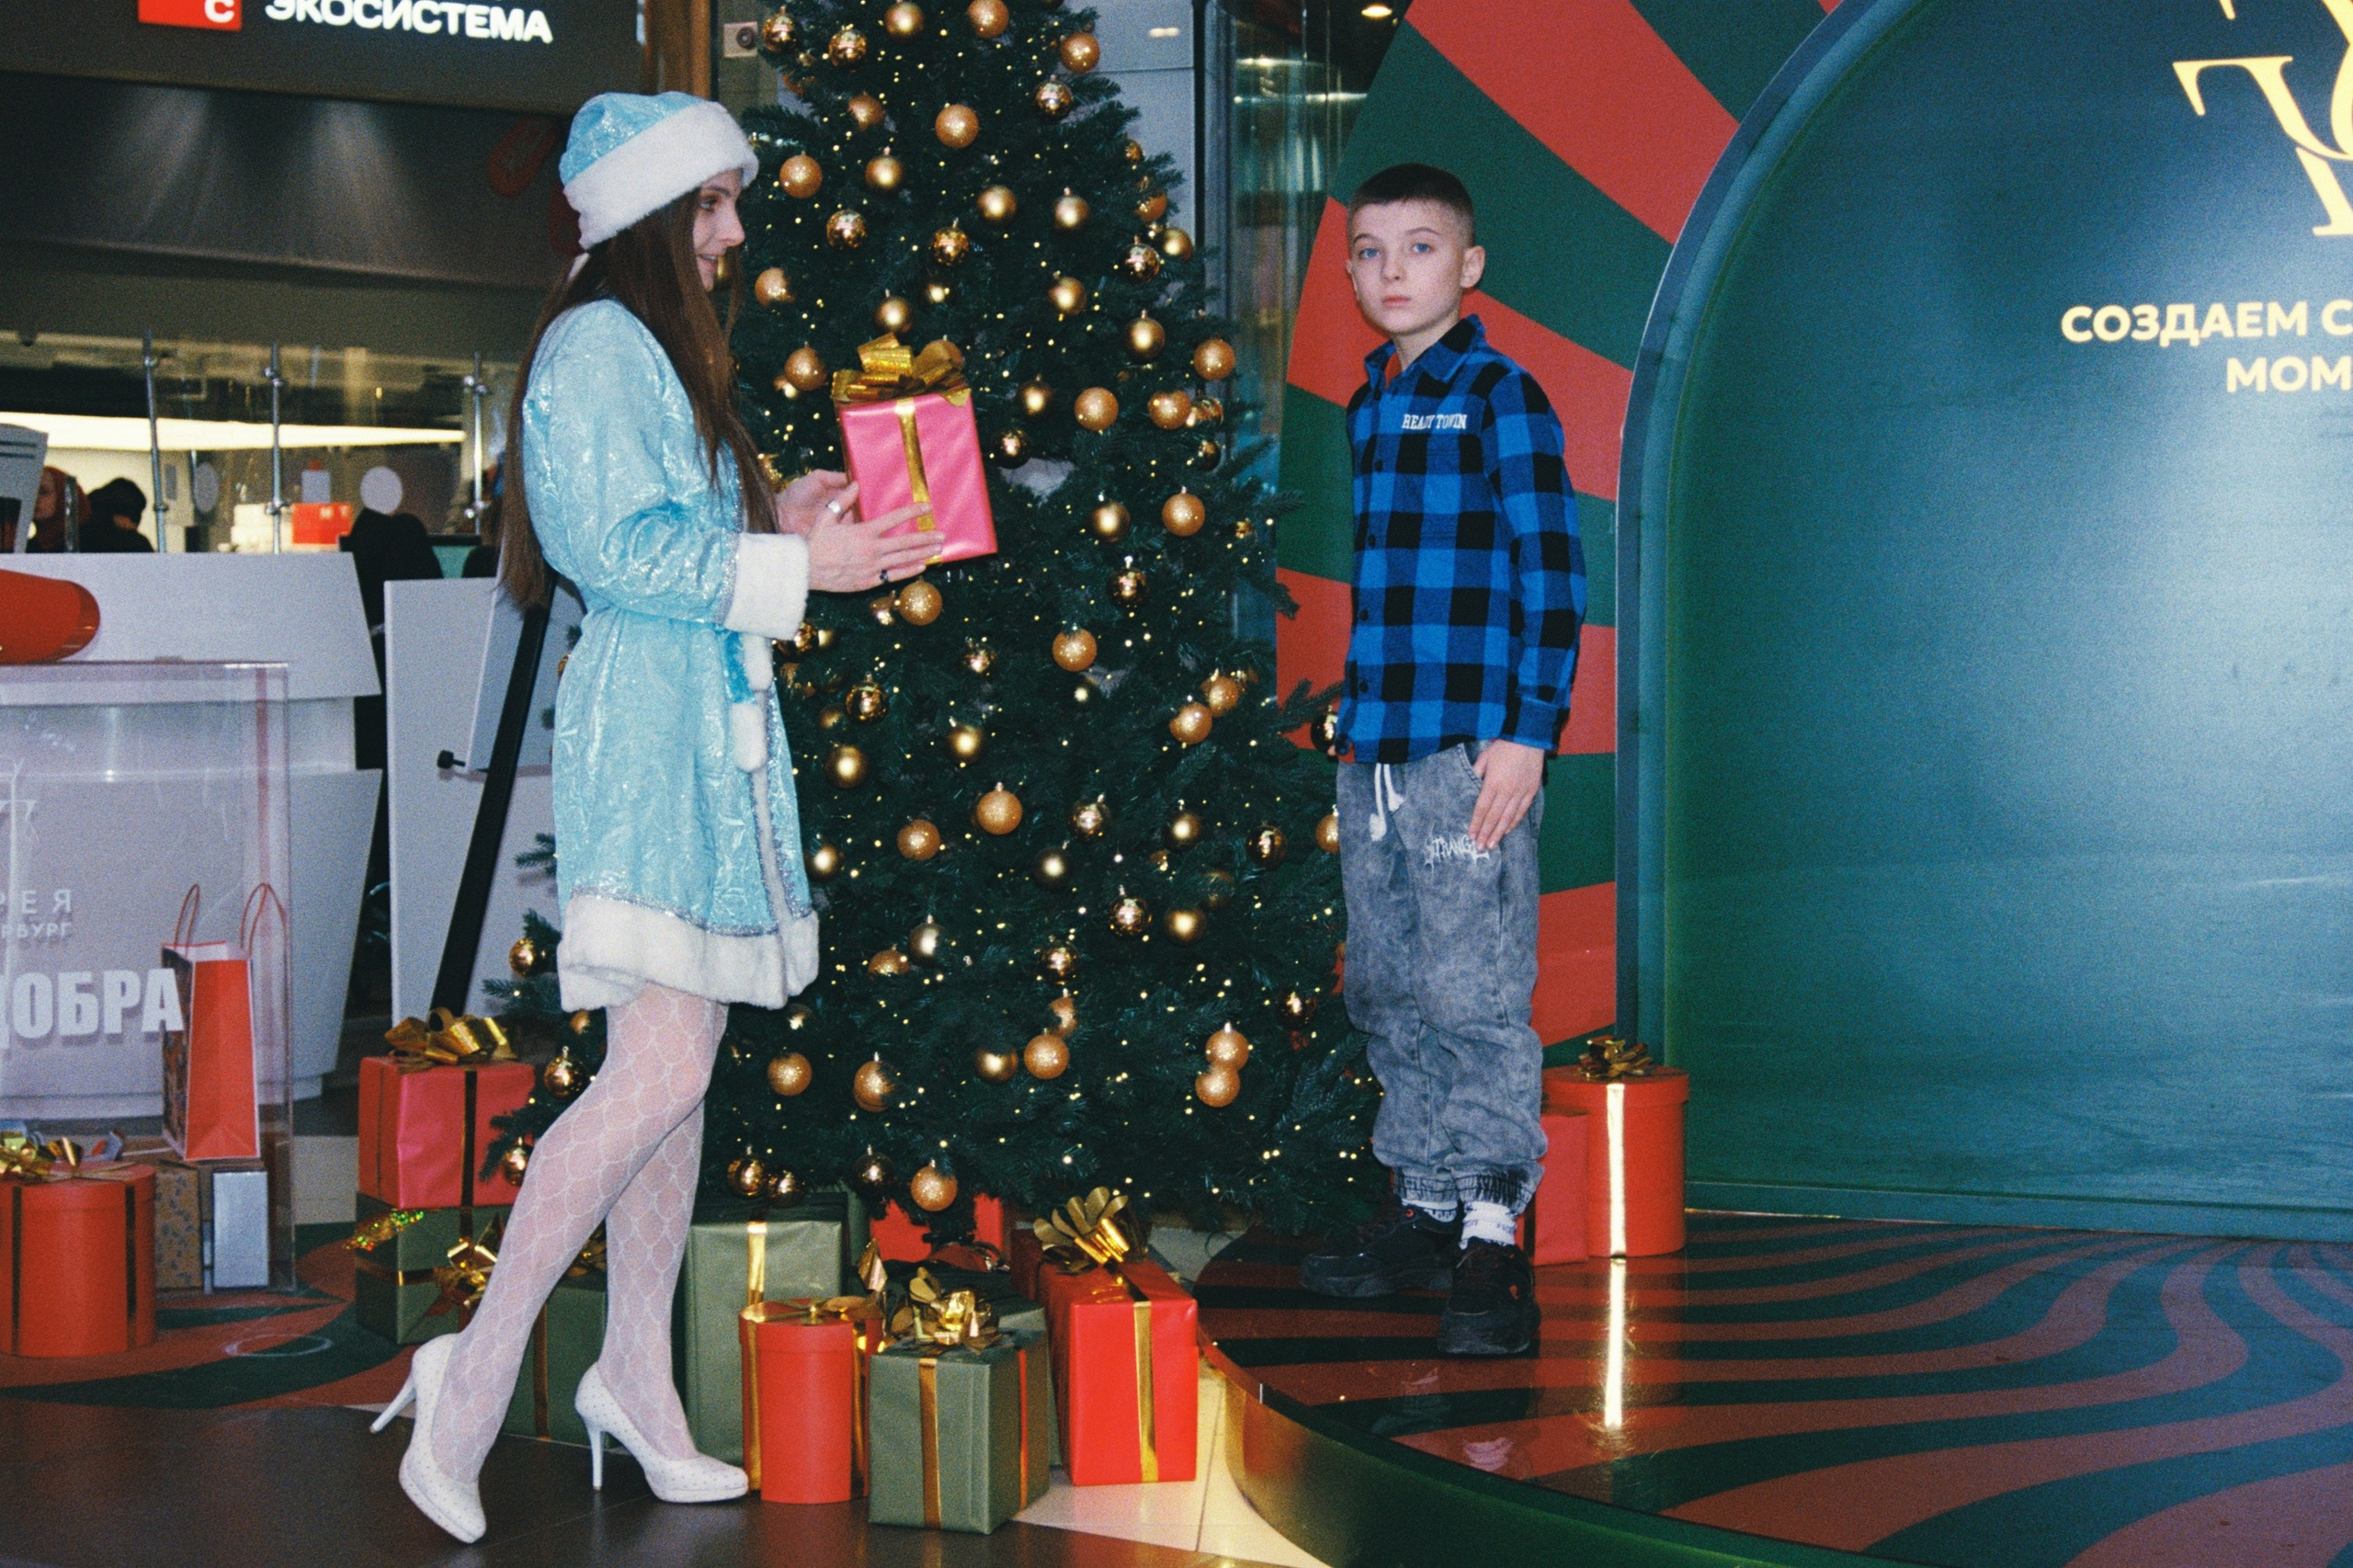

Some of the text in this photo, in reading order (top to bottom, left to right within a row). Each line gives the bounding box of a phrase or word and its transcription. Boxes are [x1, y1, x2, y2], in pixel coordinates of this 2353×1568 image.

[265, 0, 553, 44] ЭКОСИСТЕМА
[2061, 301, 2309, 347] СОЗДАЕМ
[2226, 355, 2352, 393] МОМ
